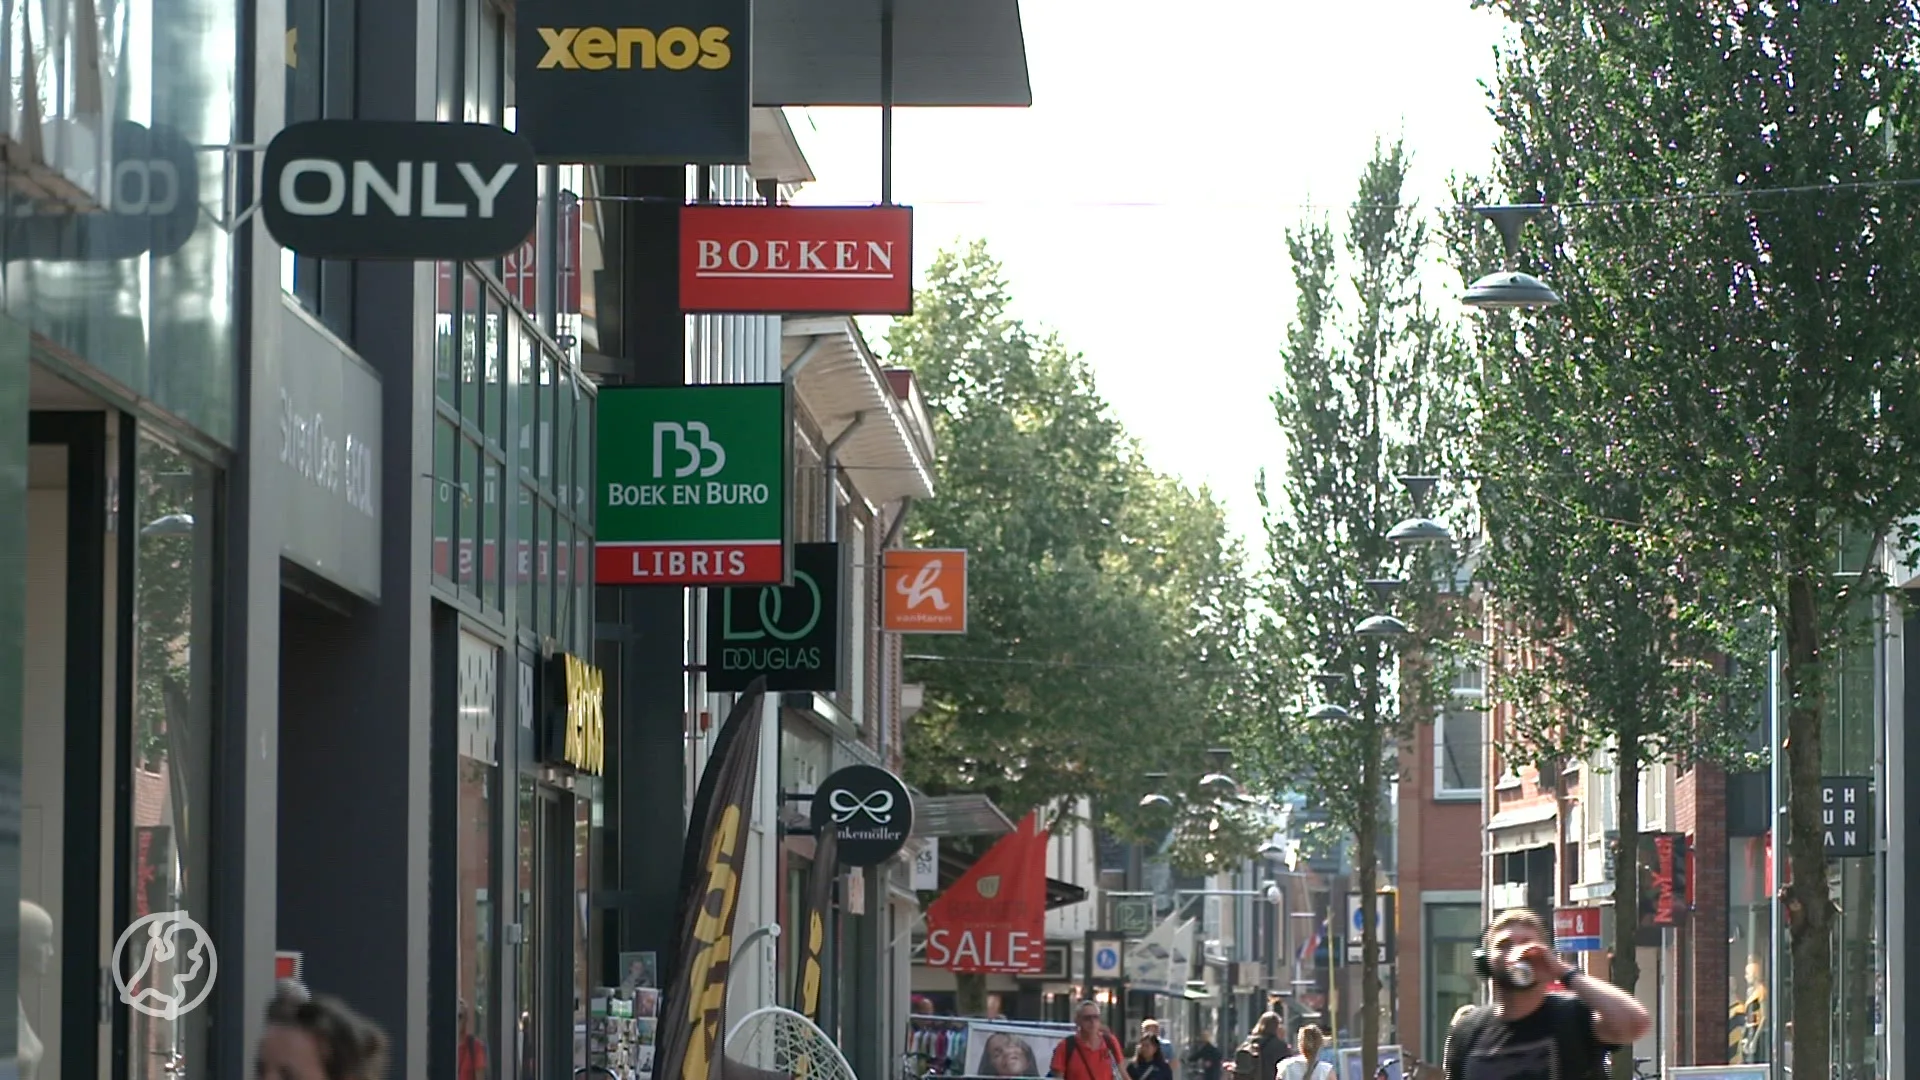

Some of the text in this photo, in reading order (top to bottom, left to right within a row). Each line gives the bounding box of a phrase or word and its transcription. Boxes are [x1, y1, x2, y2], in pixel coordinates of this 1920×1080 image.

[536, 26, 731, 71] xenos
[279, 159, 519, 218] ONLY
[696, 239, 894, 272] BOEKEN
[608, 483, 667, 506] BOEK
[673, 484, 701, 505] EN
[706, 482, 769, 505] BURO
[632, 550, 746, 577] LIBRIS
[723, 646, 821, 670] DOUGLAS
[820, 825, 902, 841] nkemöller
[929, 929, 1029, 967] SALE
